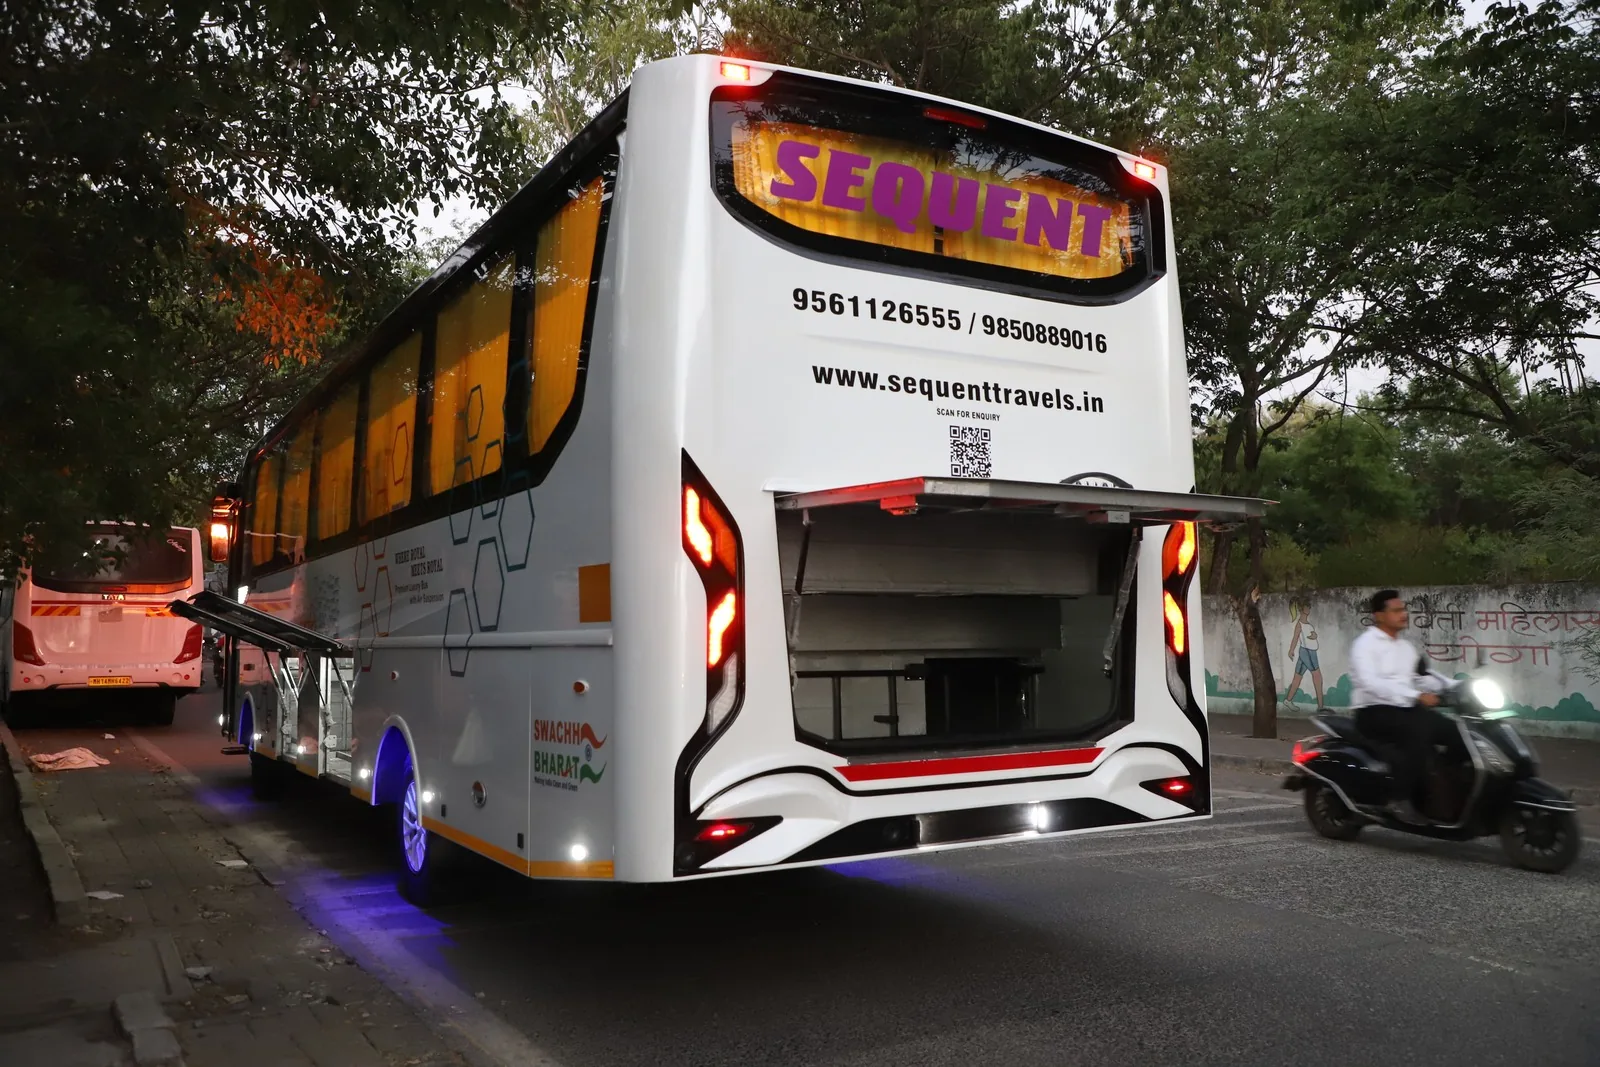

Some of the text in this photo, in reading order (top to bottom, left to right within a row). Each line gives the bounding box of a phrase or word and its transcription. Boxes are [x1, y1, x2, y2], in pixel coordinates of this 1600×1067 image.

[770, 140, 1112, 258] SEQUENT
[792, 287, 1108, 354] 9561126555 / 9850889016
[812, 365, 1104, 413] www.sequenttravels.in
[936, 407, 1000, 422] SCAN FOR ENQUIRY
[395, 545, 426, 564] WHERE ROYAL
[427, 558, 443, 574] ROYAL
[534, 719, 580, 745] SWACHH
[534, 750, 580, 779] BHARAT
